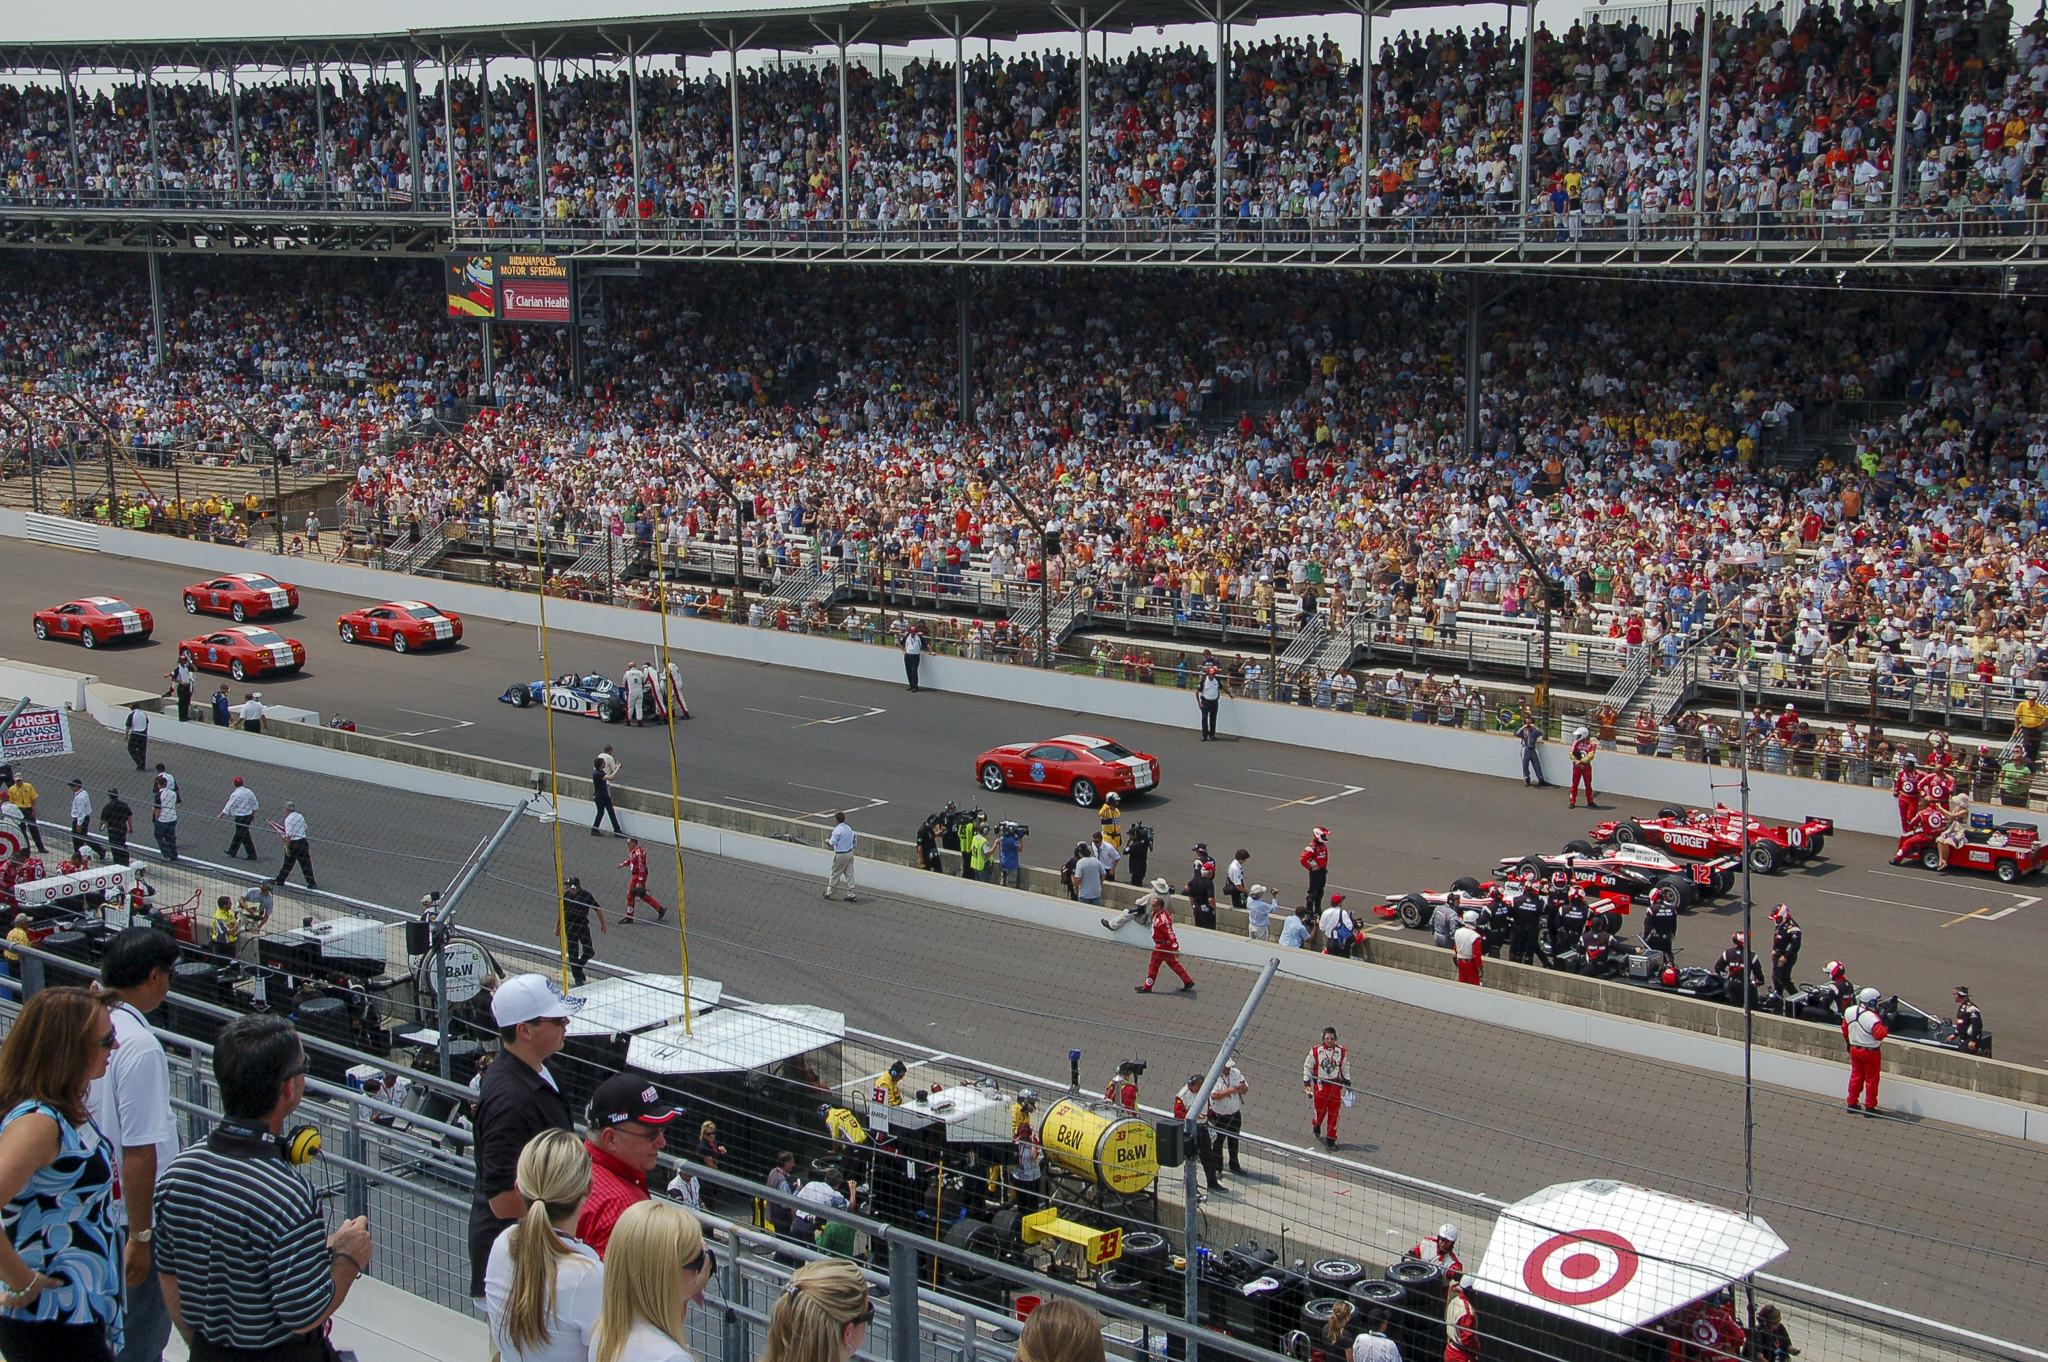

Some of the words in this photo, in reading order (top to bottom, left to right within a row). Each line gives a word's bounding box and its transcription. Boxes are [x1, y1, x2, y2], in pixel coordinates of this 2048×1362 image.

[509, 256, 556, 266] INDIANAPOLIS
[501, 267, 526, 275] MOTOR
[530, 266, 566, 276] SPEEDWAY
[516, 296, 543, 307] Clarian
[545, 296, 569, 308] Health
[15, 713, 57, 728] TARGET
[14, 724, 59, 738] GANASSI
[5, 734, 60, 745] RACING
[3, 746, 65, 758] CHAMPIONS
[1671, 833, 1709, 849] TARGET
[1786, 827, 1801, 846] 10
[1692, 864, 1711, 884] 12
[446, 963, 473, 977] B&W
[873, 1090, 884, 1102] 33
[1057, 1124, 1083, 1150] B&W
[1116, 1130, 1126, 1141] 33
[1117, 1144, 1147, 1163] B&W
[1096, 1229, 1119, 1262] 33
